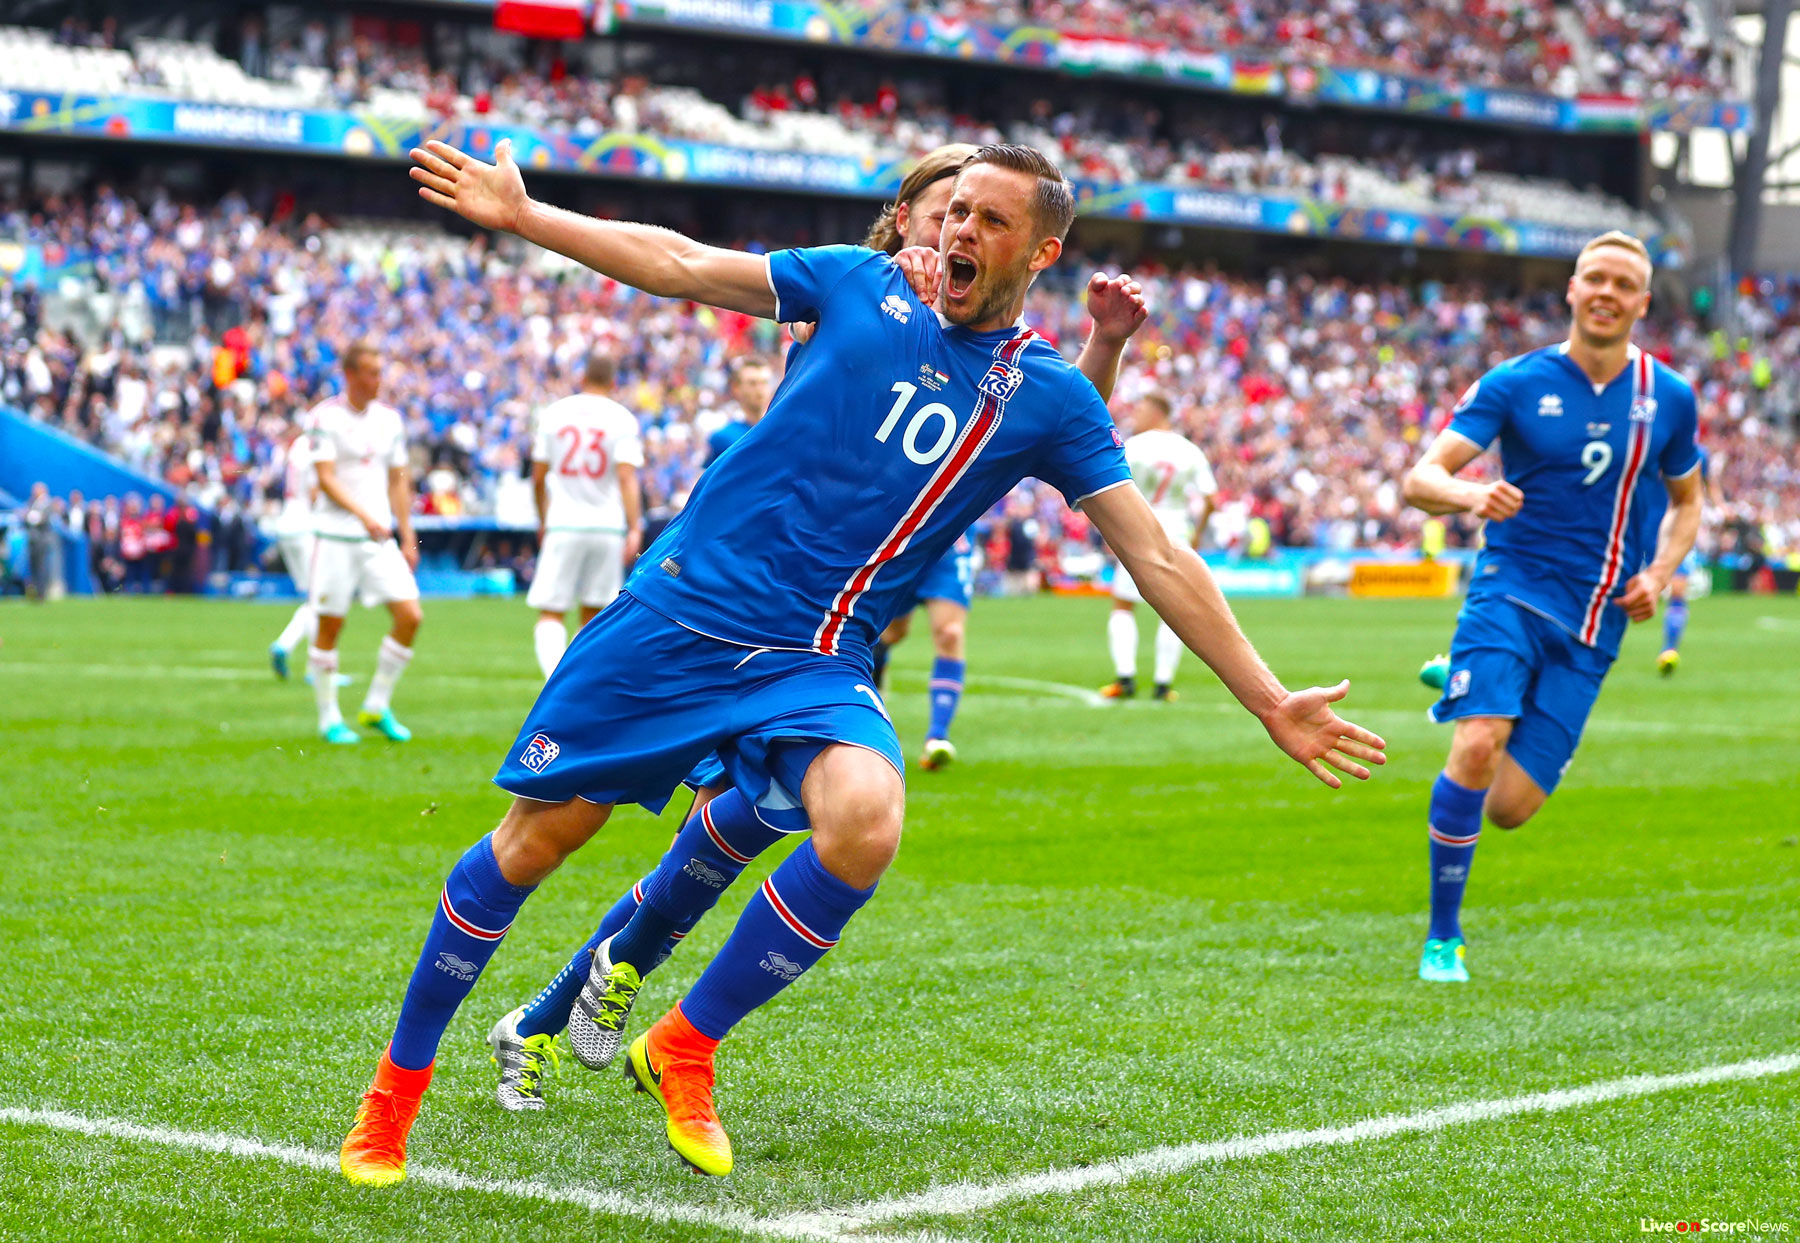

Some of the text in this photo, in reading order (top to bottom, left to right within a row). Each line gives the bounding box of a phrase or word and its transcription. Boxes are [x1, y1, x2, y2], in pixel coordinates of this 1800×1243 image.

[880, 301, 909, 324] errea
[874, 381, 957, 465] 10
[557, 425, 607, 479] 23
[1581, 440, 1613, 485] 9
